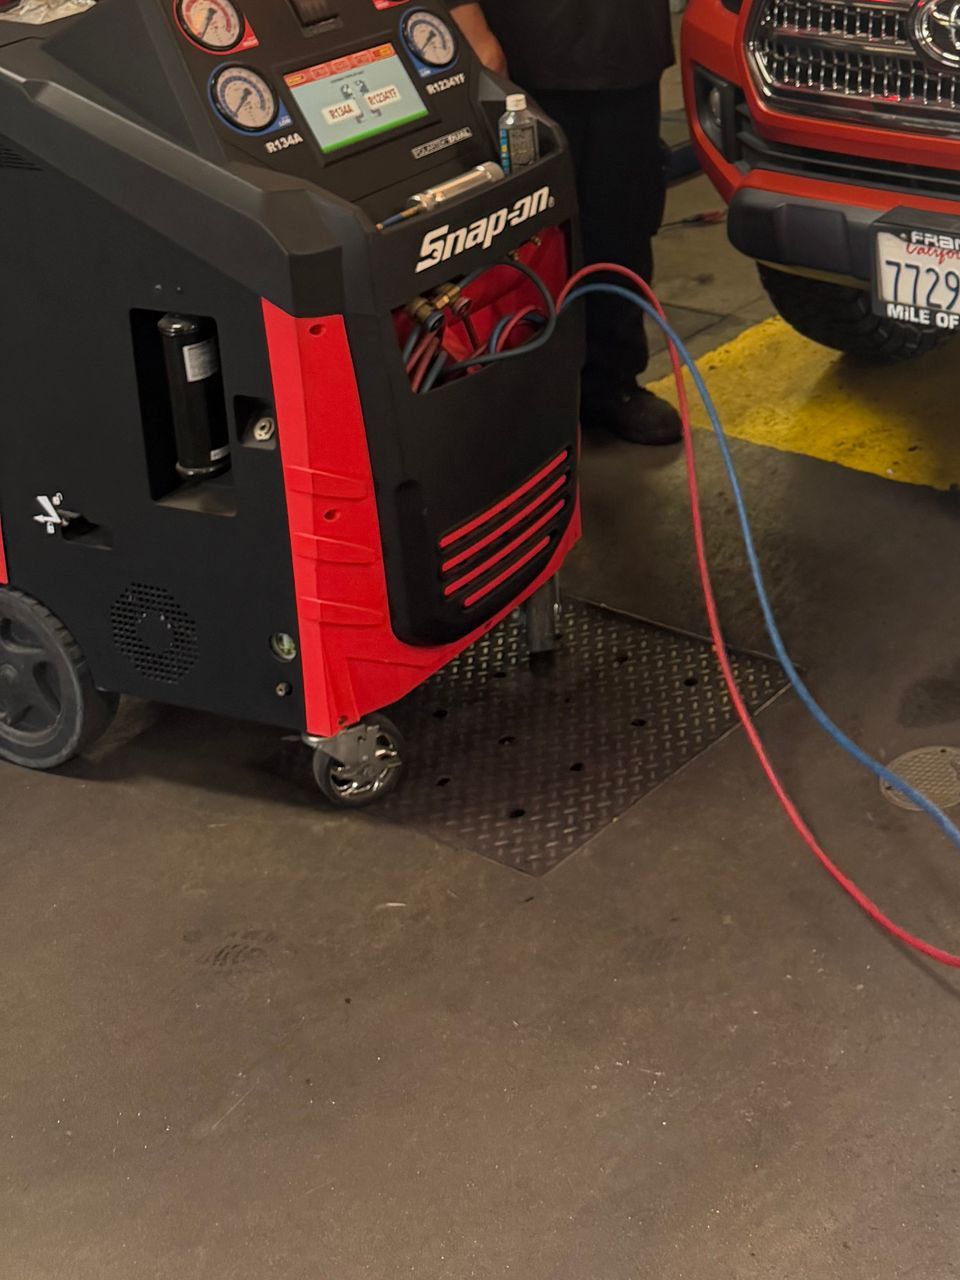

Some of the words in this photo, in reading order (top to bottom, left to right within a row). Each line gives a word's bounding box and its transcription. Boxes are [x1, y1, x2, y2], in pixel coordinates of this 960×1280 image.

[426, 73, 466, 96] R1234YF
[265, 133, 304, 155] R134A
[415, 186, 550, 272] Snap-on
[935, 312, 959, 329] OF
